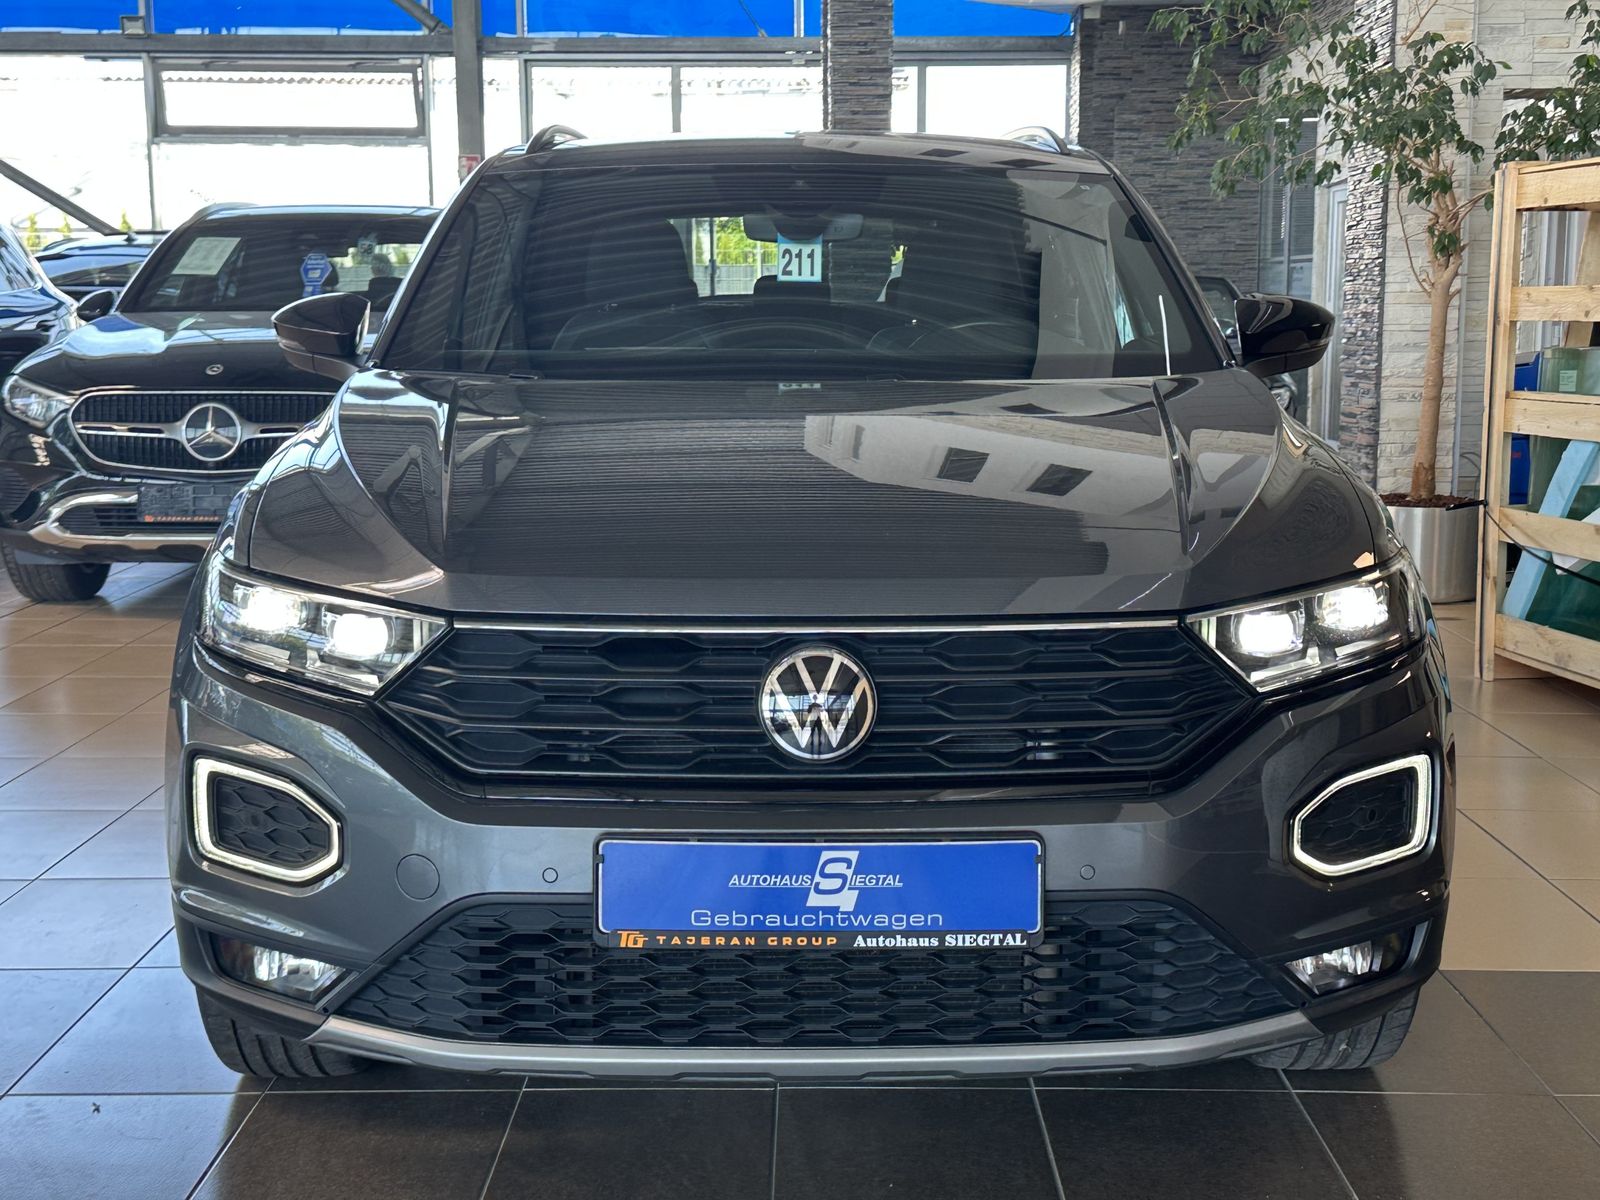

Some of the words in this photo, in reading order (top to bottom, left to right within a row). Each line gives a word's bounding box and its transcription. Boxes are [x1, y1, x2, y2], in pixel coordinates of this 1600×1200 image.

[781, 247, 815, 277] 211
[728, 874, 812, 887] AUTOHAUS
[690, 909, 943, 930] Gebrauchtwagen
[656, 936, 756, 945] TAJERAN
[767, 936, 837, 946] GROUP
[853, 934, 939, 948] Autohaus
[944, 933, 1027, 947] SIEGTAL
